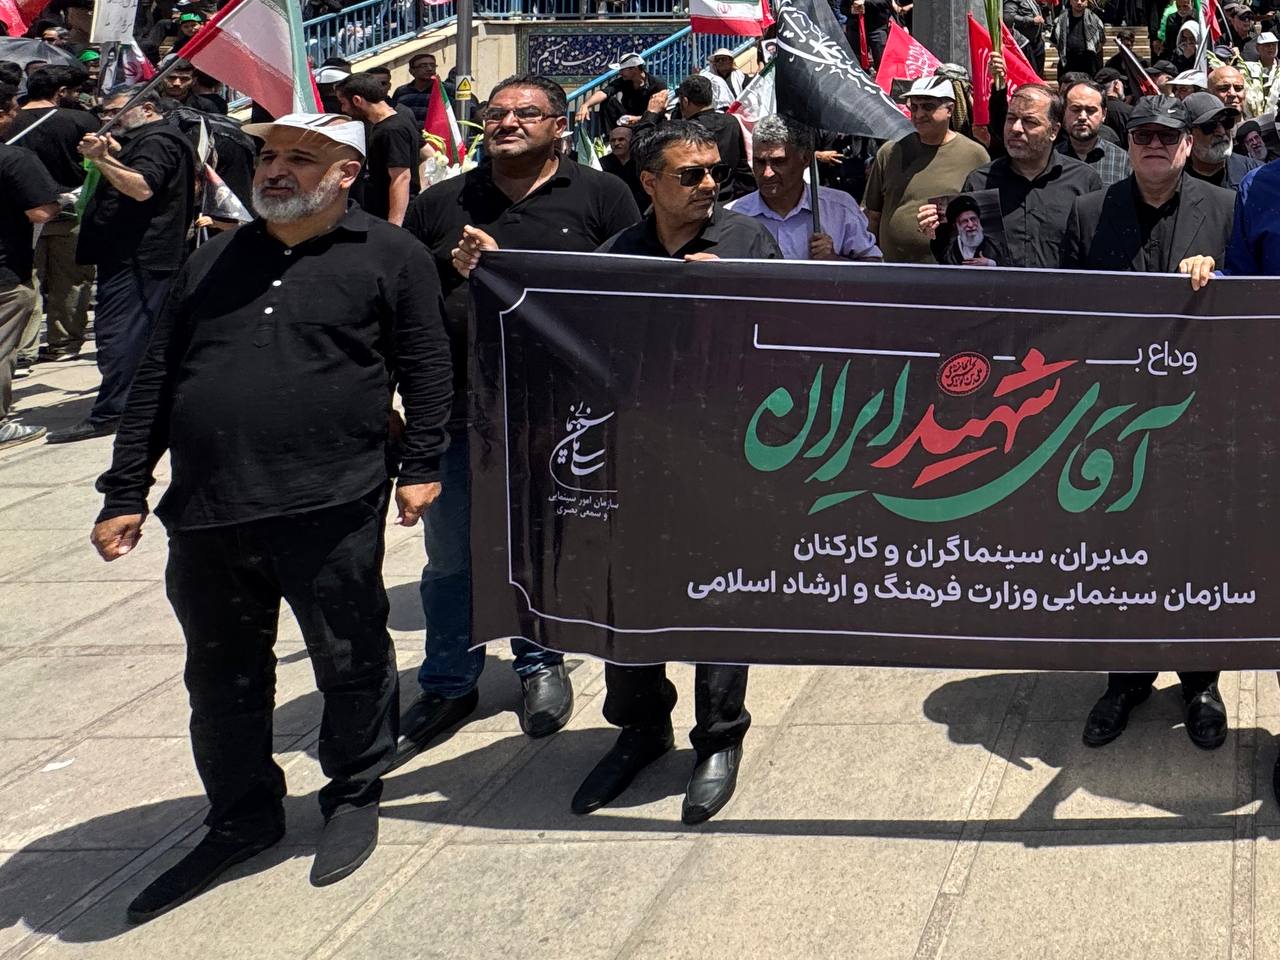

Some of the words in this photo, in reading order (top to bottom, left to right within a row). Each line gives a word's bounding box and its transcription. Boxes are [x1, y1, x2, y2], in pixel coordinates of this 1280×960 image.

[1147, 341, 1197, 375] وداع
[869, 347, 1079, 489] شهید
[744, 359, 910, 515] ایران
[872, 382, 1195, 522] آقای
[548, 490, 577, 504] سینمایی
[556, 506, 578, 516] بصری
[578, 495, 592, 507] امور
[594, 497, 619, 510] سازمان
[580, 510, 602, 518] سمعی
[603, 512, 608, 521] و
[793, 533, 878, 563] کارکنان
[884, 543, 899, 566] و
[905, 535, 1044, 569] سینماگران
[1050, 542, 1149, 572] مدیران،
[687, 568, 776, 599] اسلامی
[782, 572, 847, 603] ارشاد
[853, 584, 868, 604] و
[874, 573, 962, 607] فرهنگ
[967, 581, 1038, 610] وزارت
[1042, 582, 1157, 611] سینمایی
[1163, 582, 1256, 611] سازمان
